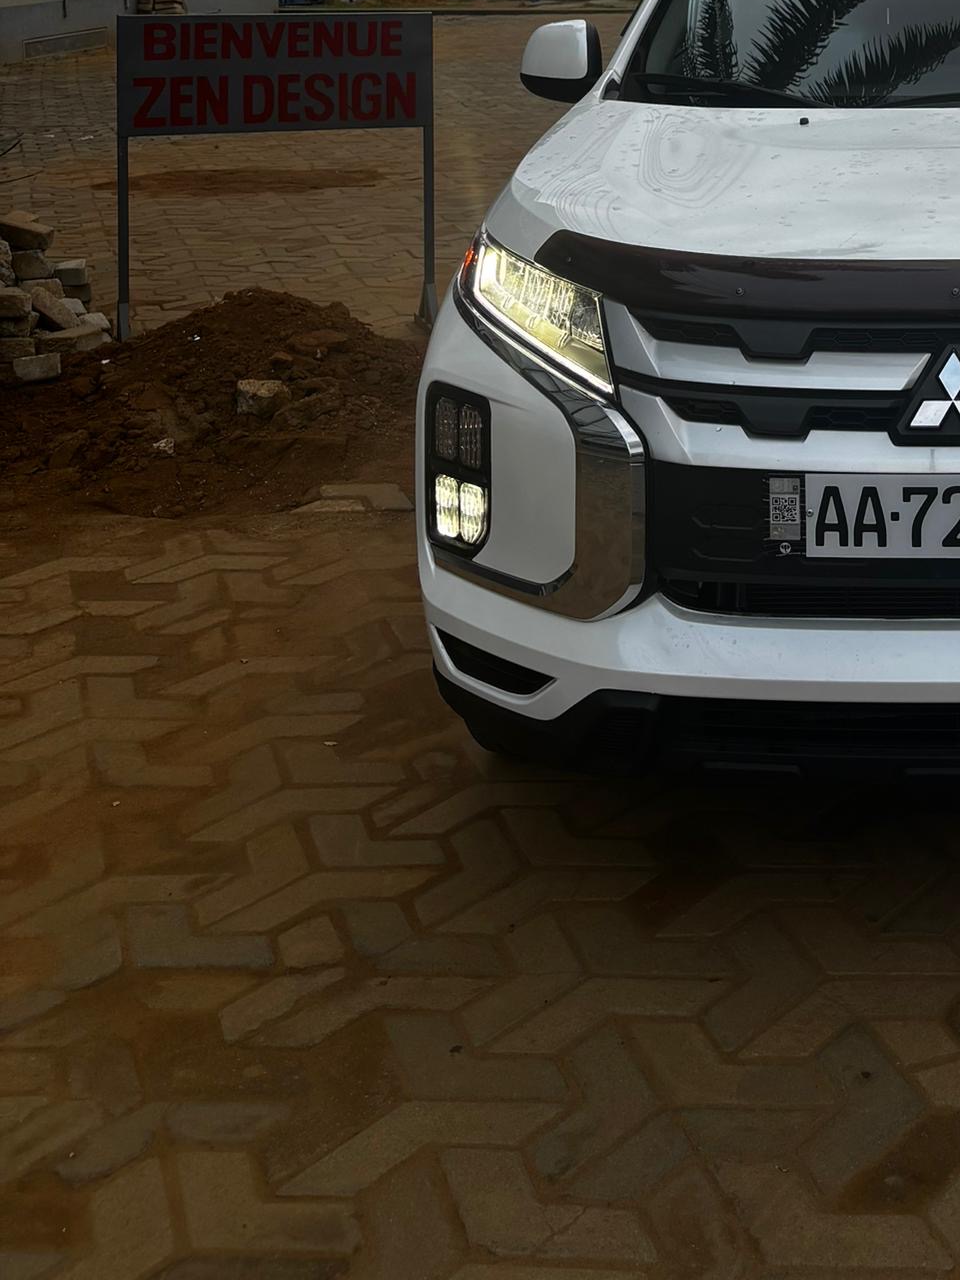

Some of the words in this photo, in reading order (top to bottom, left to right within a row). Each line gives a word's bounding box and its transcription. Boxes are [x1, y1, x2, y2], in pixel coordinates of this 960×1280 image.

[143, 20, 403, 61] BIENVENUE
[132, 75, 229, 129] ZEN
[242, 72, 417, 124] DESIGN
